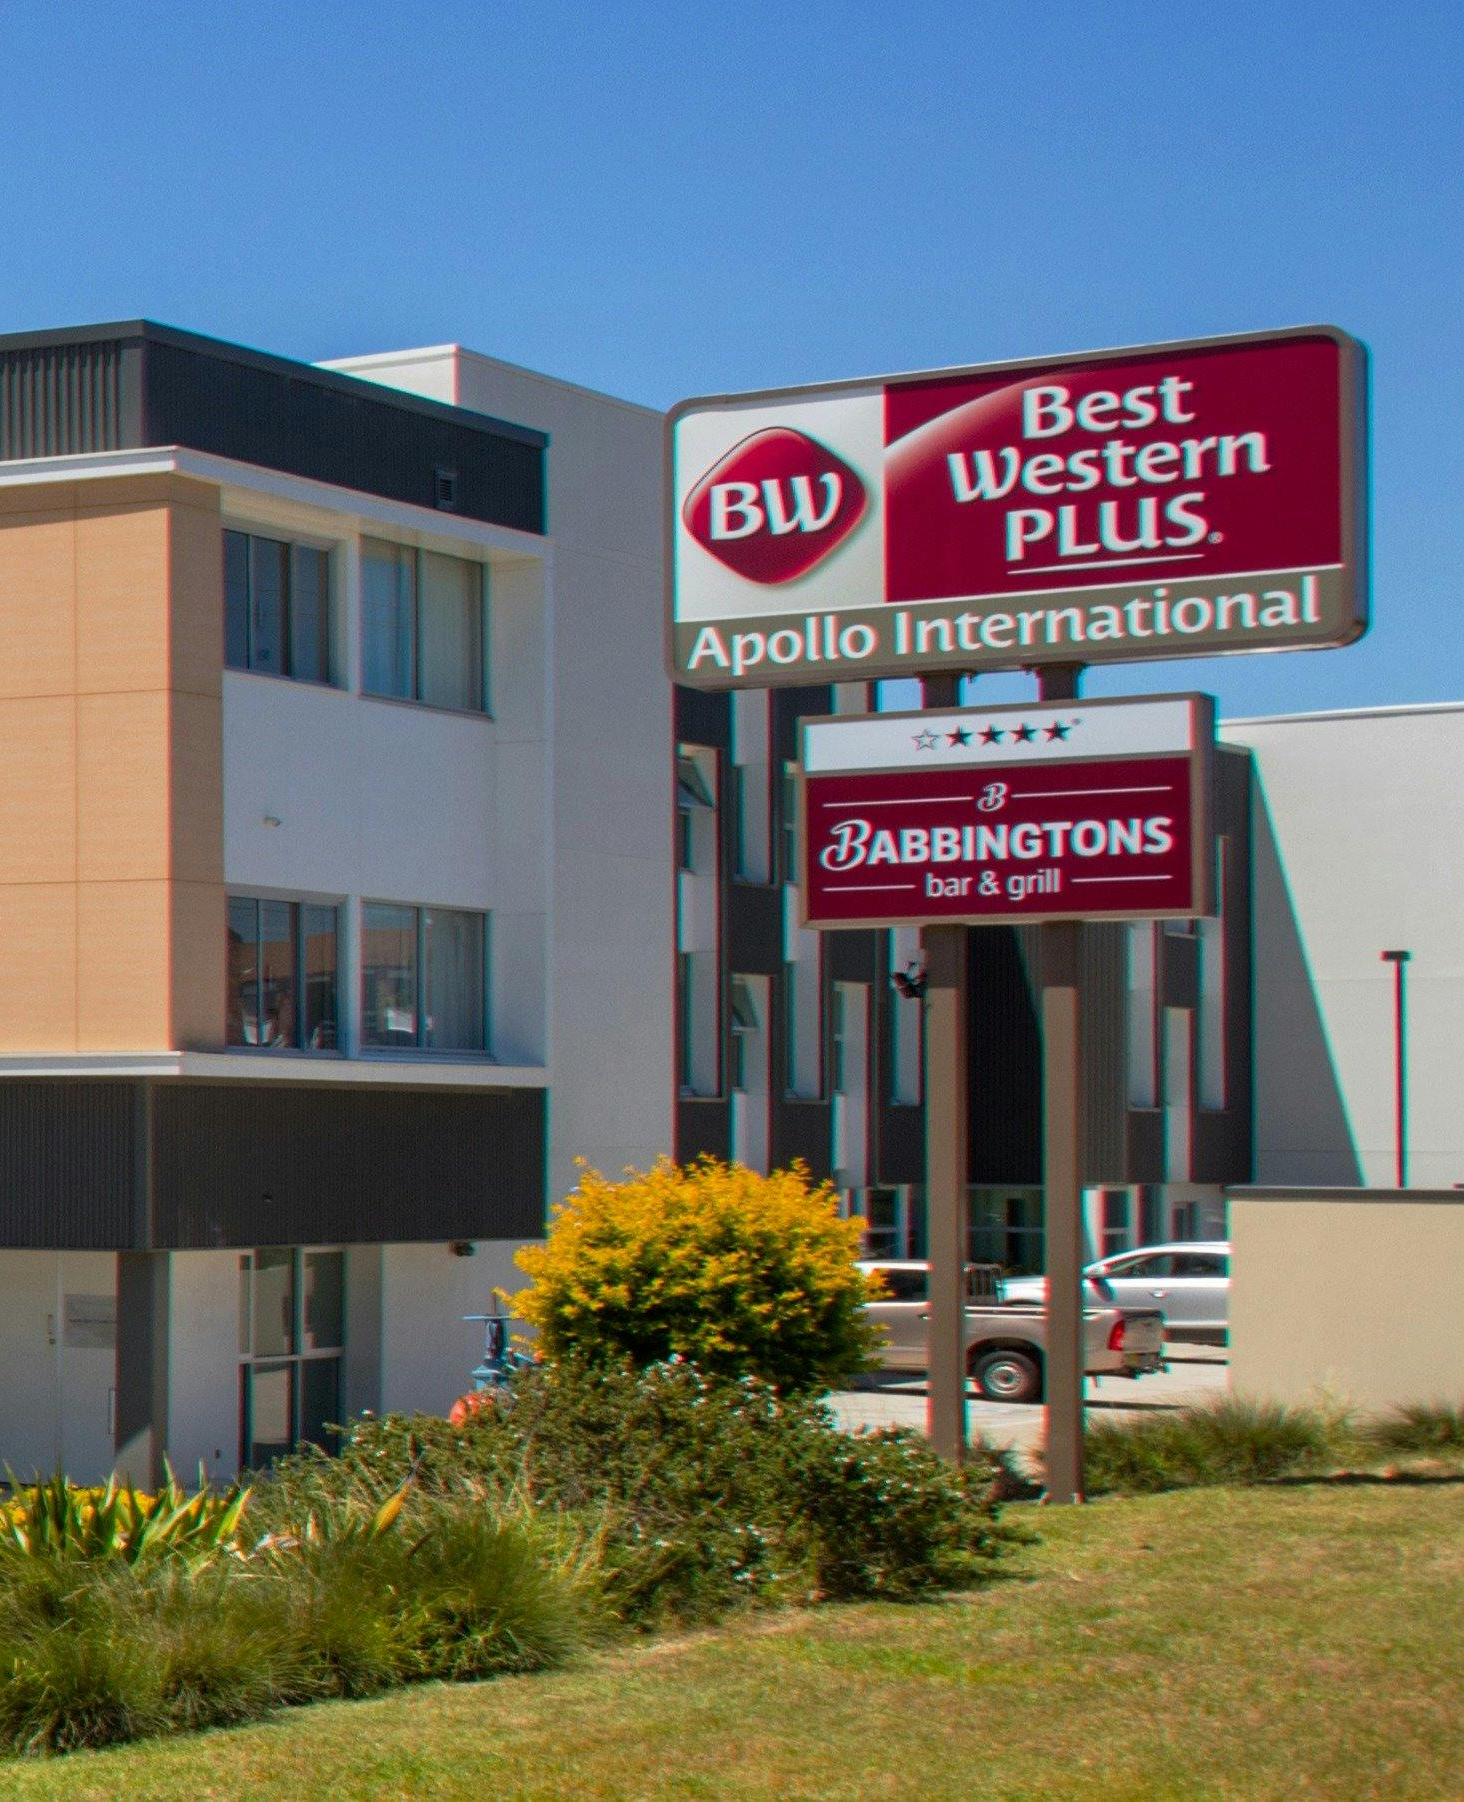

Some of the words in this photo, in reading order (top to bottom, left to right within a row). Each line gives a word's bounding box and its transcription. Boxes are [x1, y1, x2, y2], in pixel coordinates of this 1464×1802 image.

[1022, 376, 1197, 440] Best
[947, 431, 1272, 502] Western
[710, 472, 843, 540] BW
[687, 613, 879, 677] Apollo
[894, 574, 1321, 655] International
[977, 782, 1008, 812] B
[818, 816, 1174, 872] BABBINGTONS
[925, 870, 973, 898] bar
[977, 869, 1002, 896] &
[1007, 867, 1062, 901] grill
